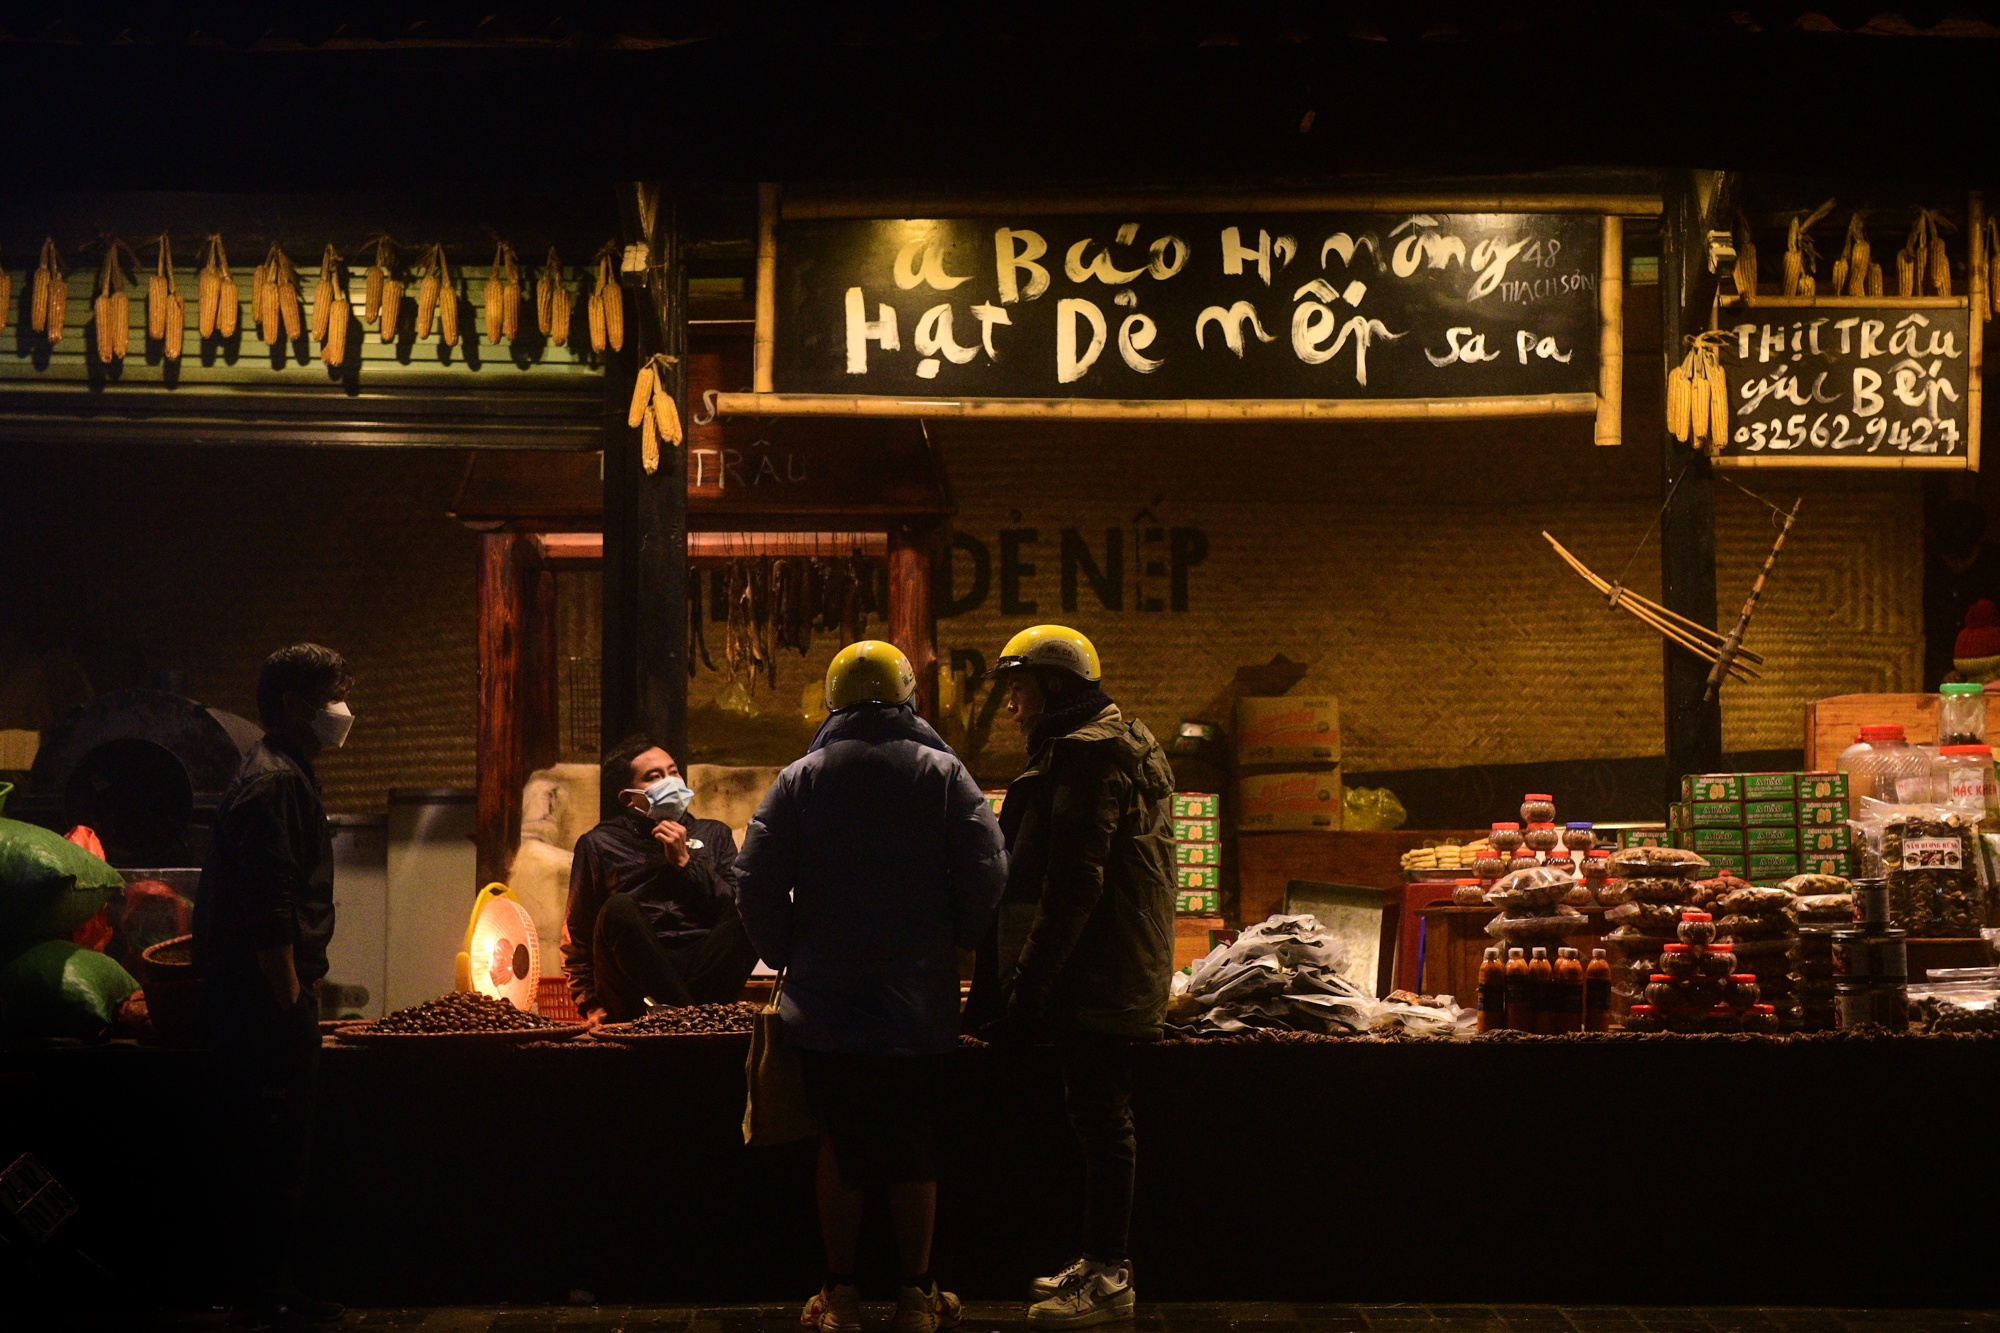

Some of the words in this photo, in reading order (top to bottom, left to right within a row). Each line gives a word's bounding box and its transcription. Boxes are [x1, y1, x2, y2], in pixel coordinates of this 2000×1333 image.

[1522, 239, 1560, 269] 48
[846, 287, 1012, 379] Hạt
[1058, 288, 1164, 383] Dẻ
[1853, 358, 1959, 424] Bếp
